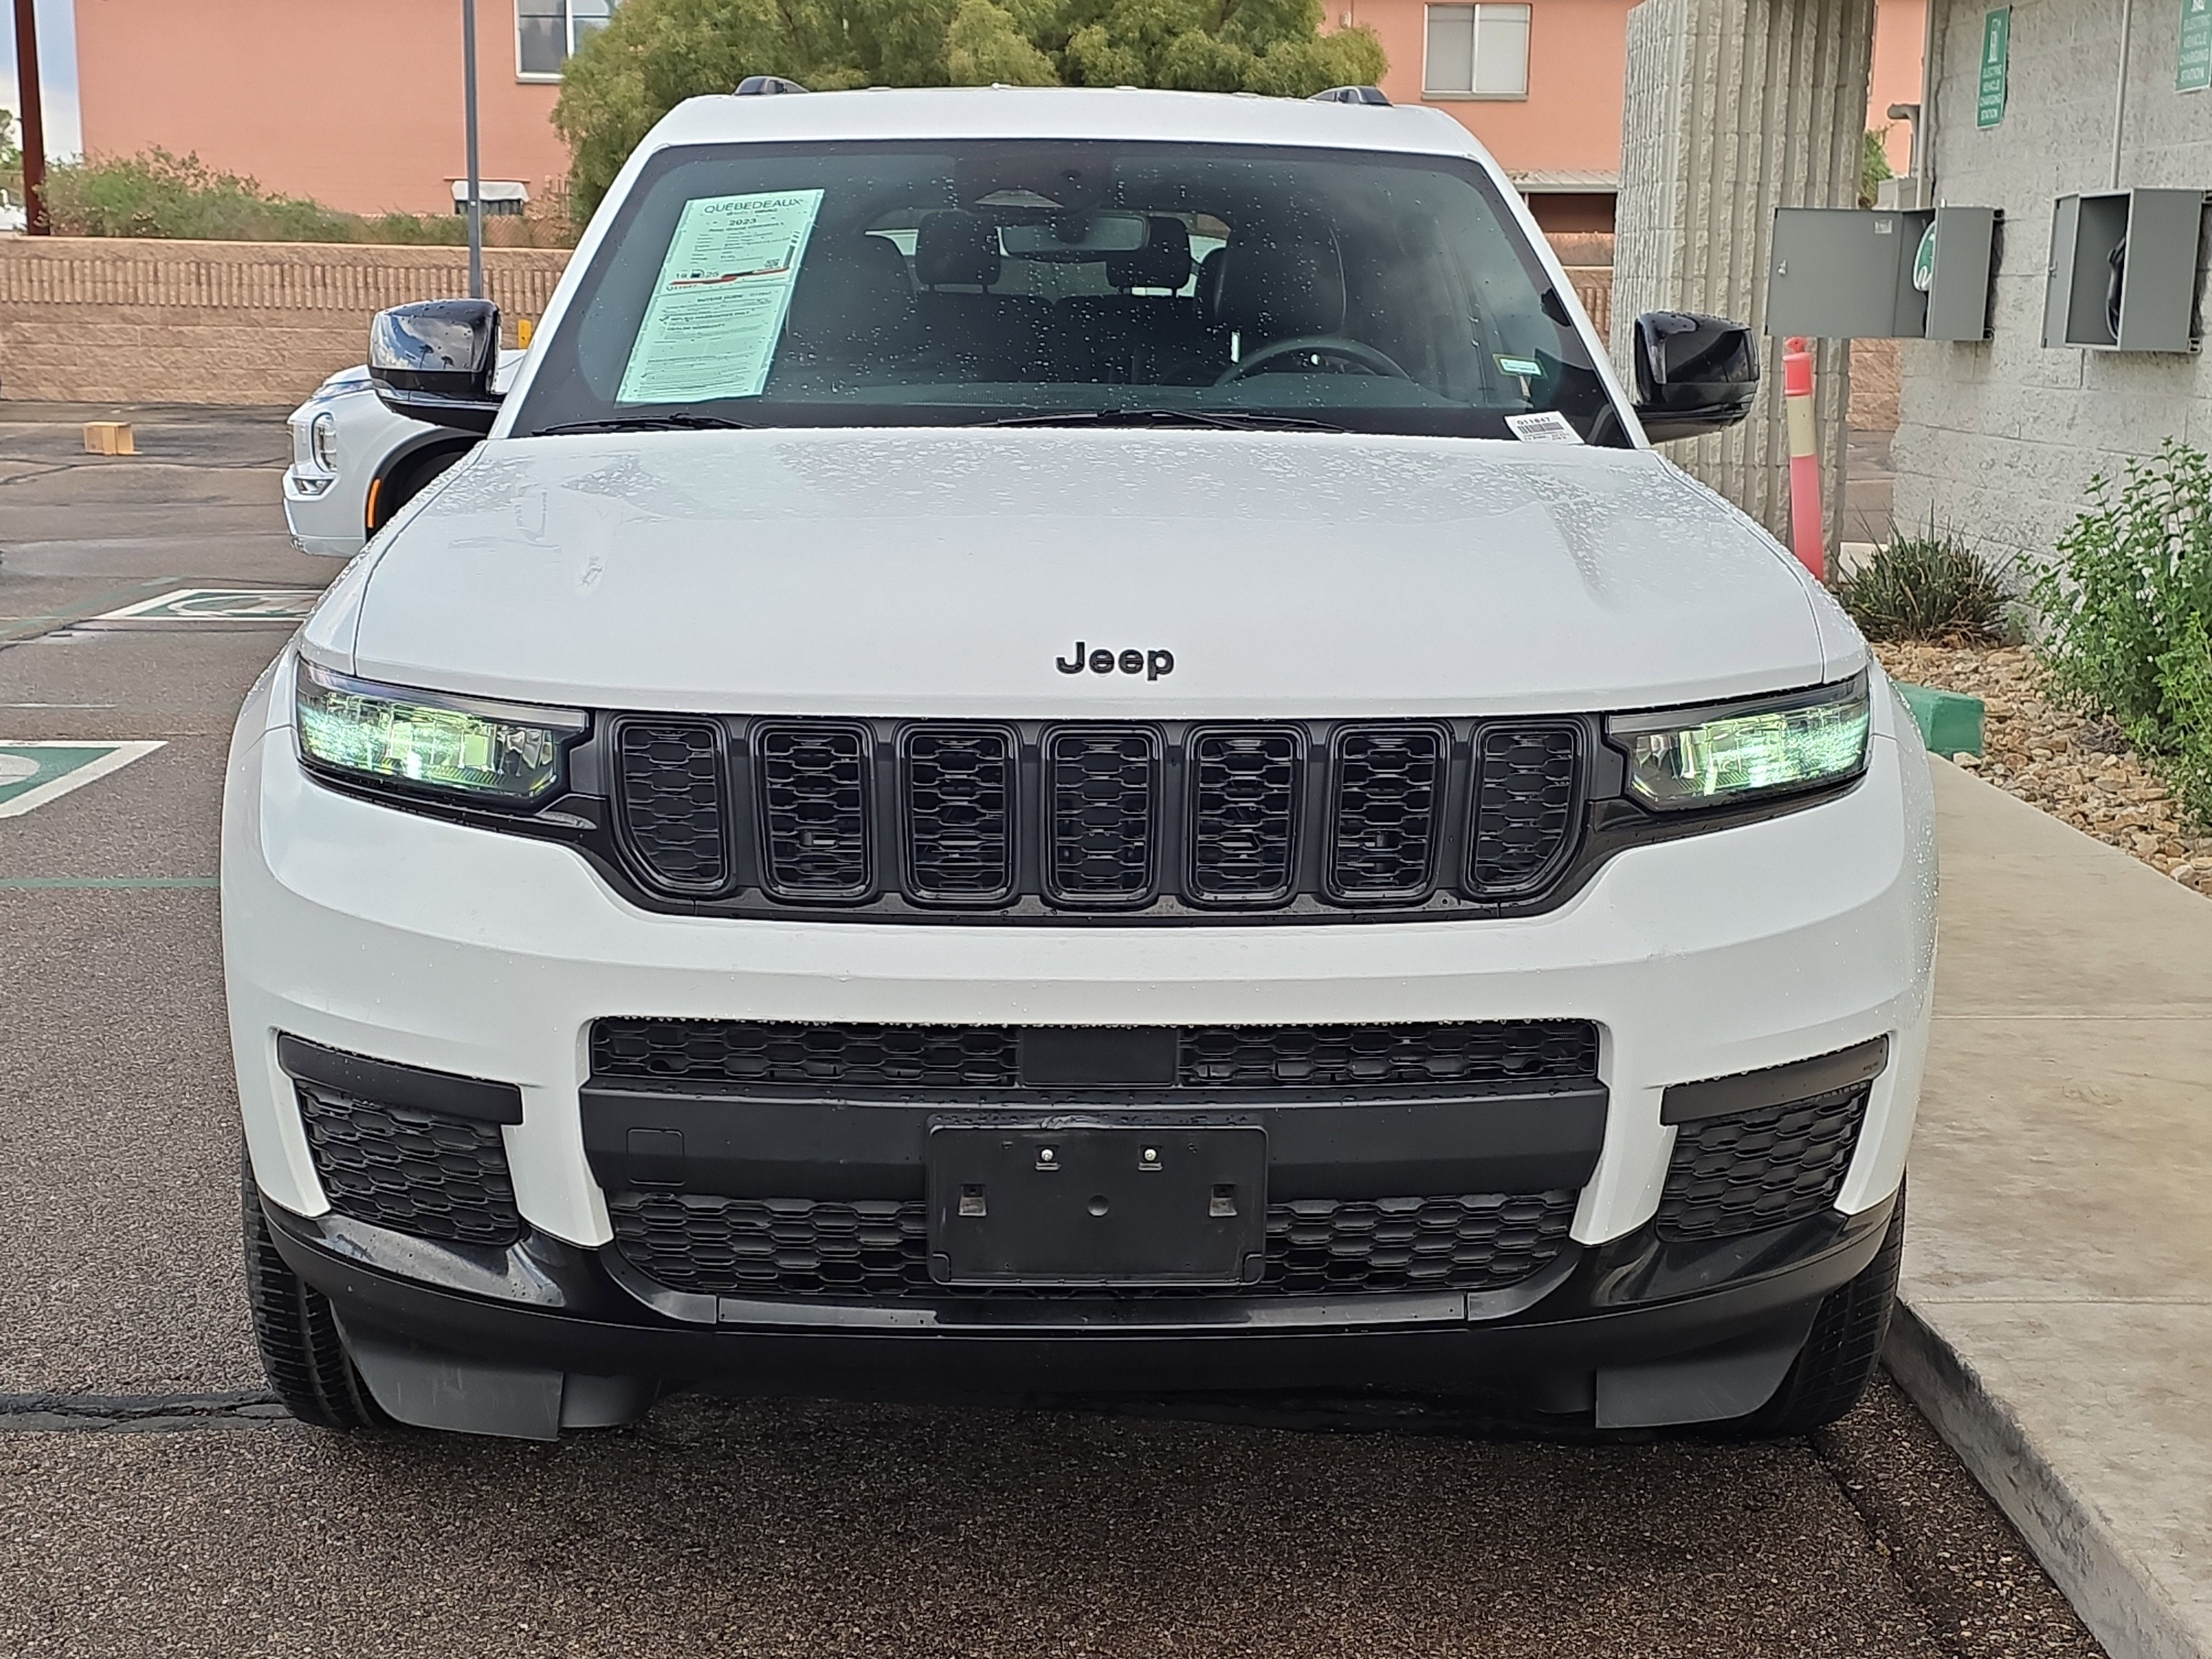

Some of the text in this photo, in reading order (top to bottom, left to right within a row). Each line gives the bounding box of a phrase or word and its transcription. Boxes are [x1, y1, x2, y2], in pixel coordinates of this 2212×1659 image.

[705, 198, 803, 213] QUEBEDEAUX
[729, 218, 757, 226] 2023
[1056, 642, 1174, 680] Jeep
